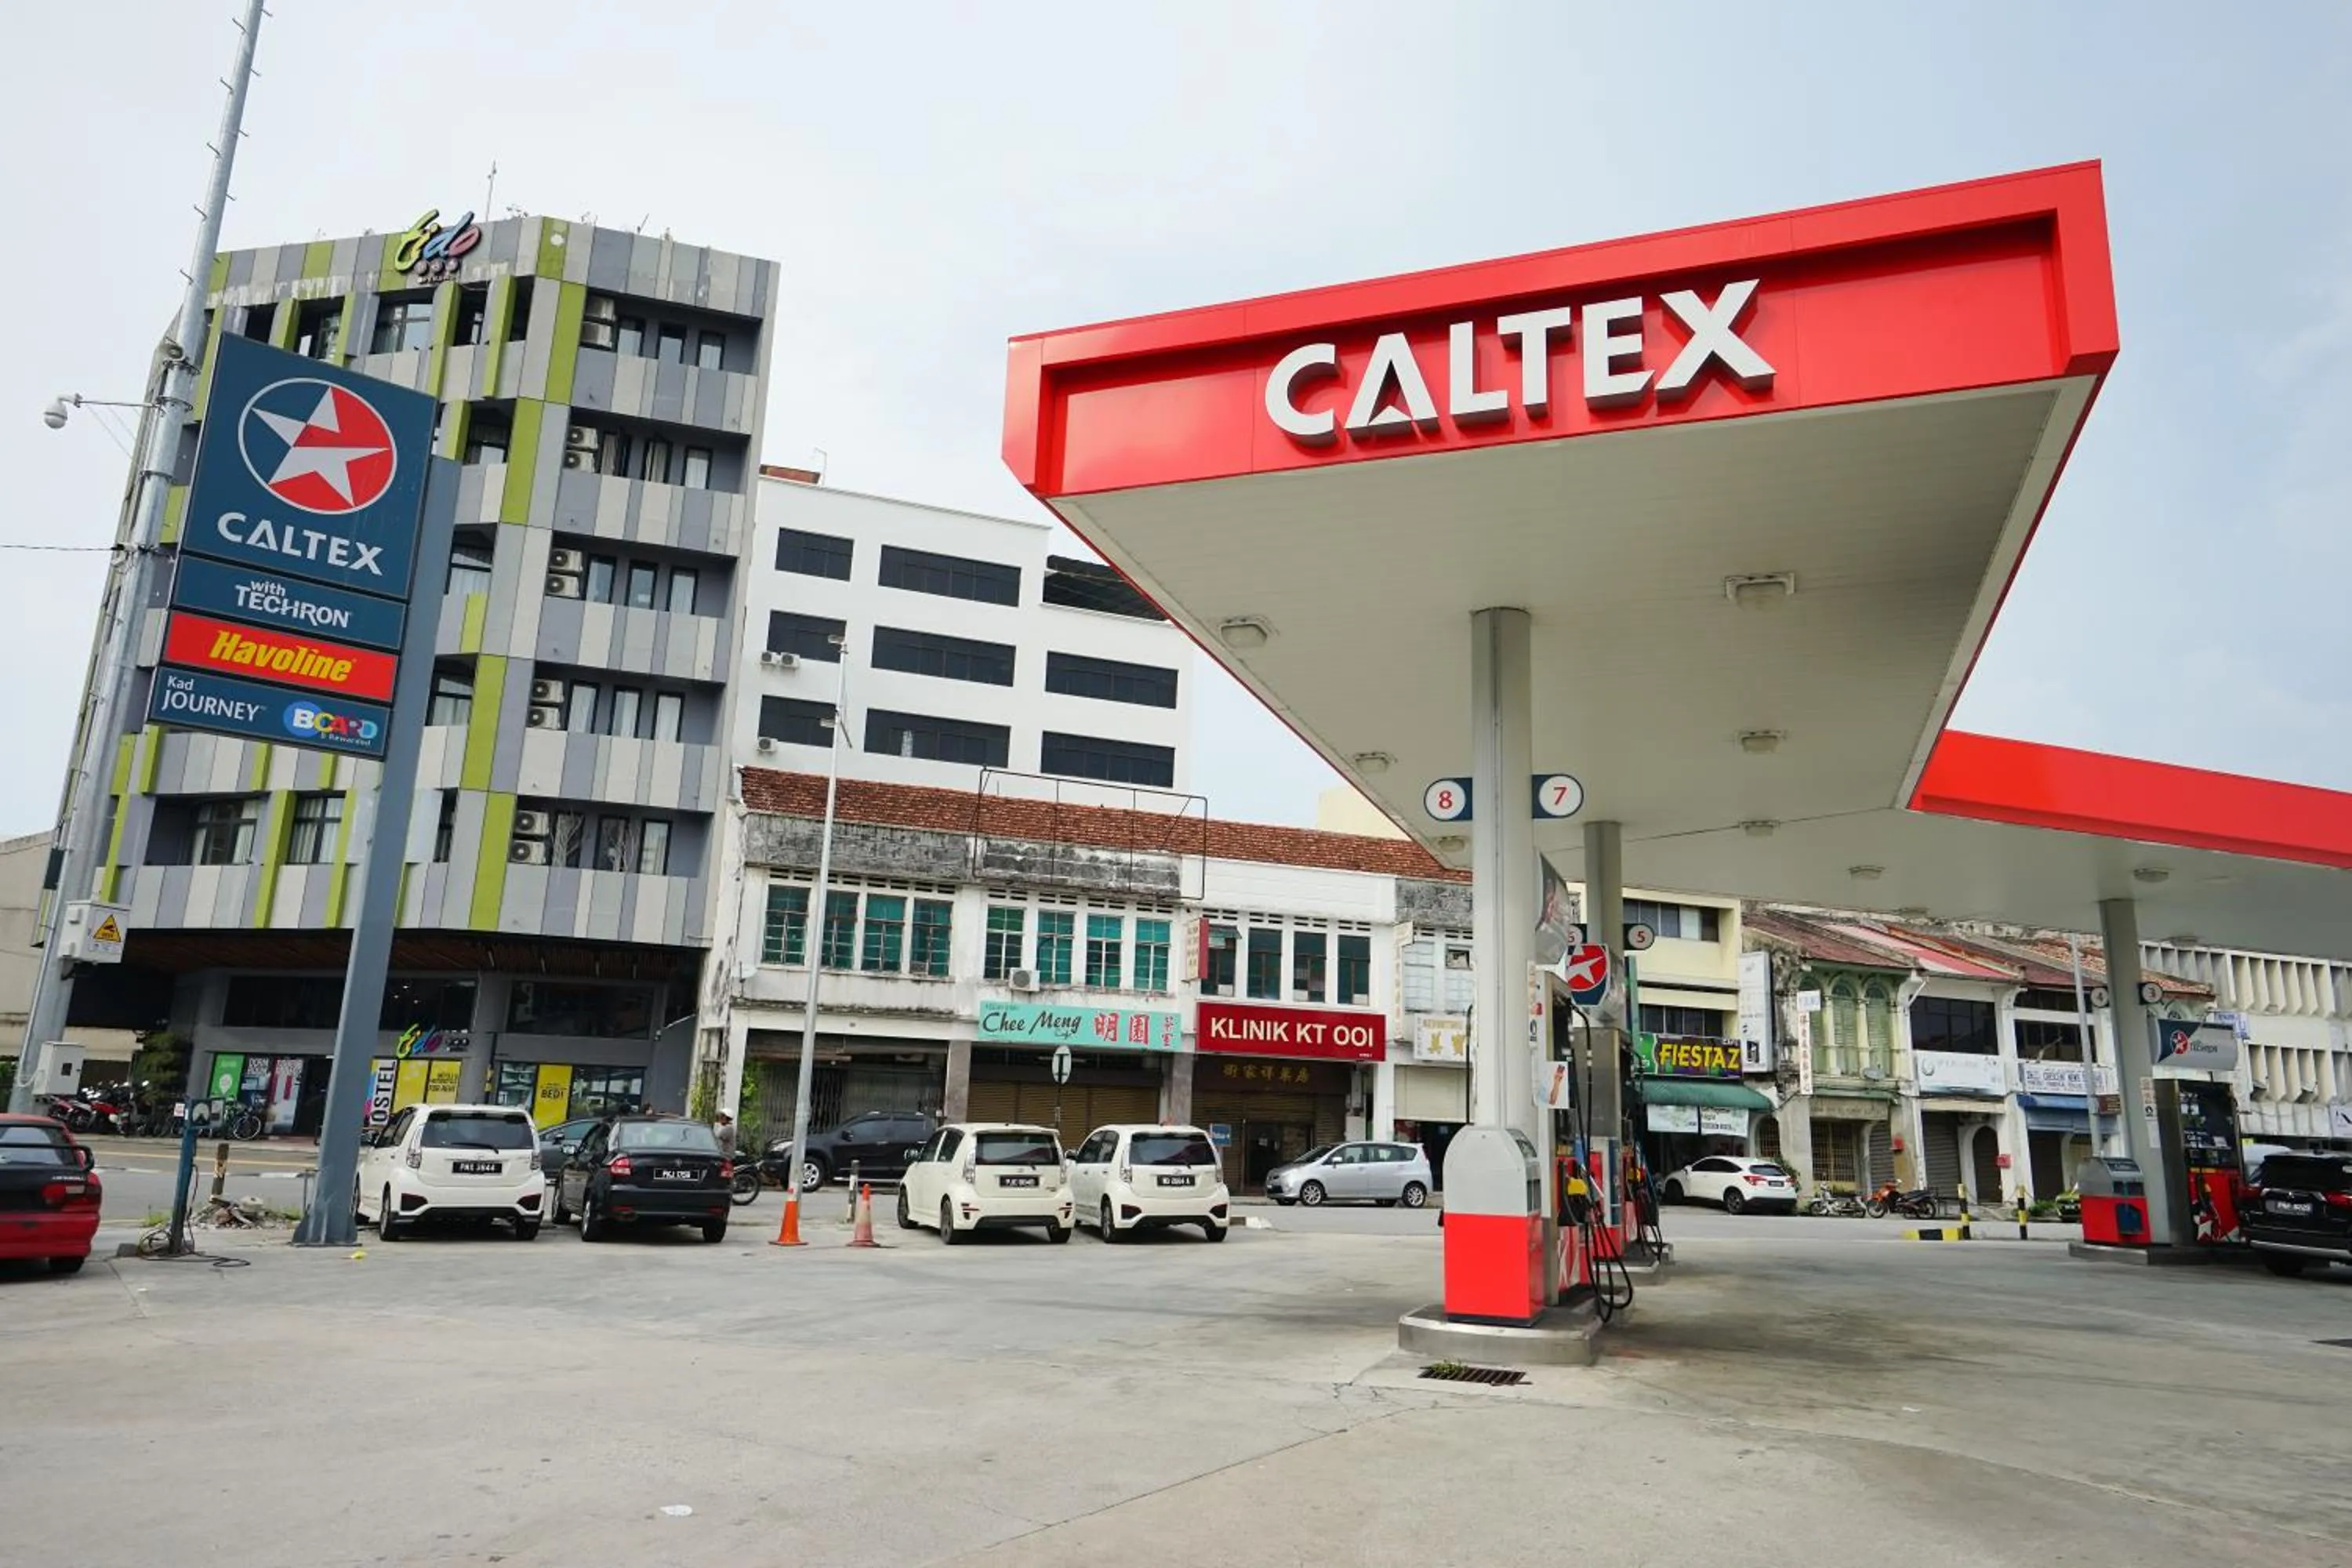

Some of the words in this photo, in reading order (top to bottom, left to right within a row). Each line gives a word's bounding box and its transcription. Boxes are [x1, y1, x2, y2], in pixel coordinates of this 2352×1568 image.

[1264, 278, 1777, 441] CALTEX
[217, 511, 383, 576] CALTEX
[250, 580, 286, 597] with
[235, 585, 350, 628] TECHRON
[209, 630, 353, 682] Havoline
[167, 675, 194, 691] Kad
[161, 689, 261, 722] JOURNEY
[1438, 789, 1453, 809] 8
[1552, 786, 1568, 806] 7
[1636, 931, 1646, 943] 5
[982, 1011, 1025, 1033] Chee
[1029, 1010, 1082, 1034] Meng
[1210, 1017, 1290, 1042] KLINIK
[1296, 1023, 1327, 1044] KT
[1333, 1025, 1374, 1047] OOI
[1659, 1044, 1740, 1069] FIESTAZ
[371, 1061, 396, 1123] OSTEL
